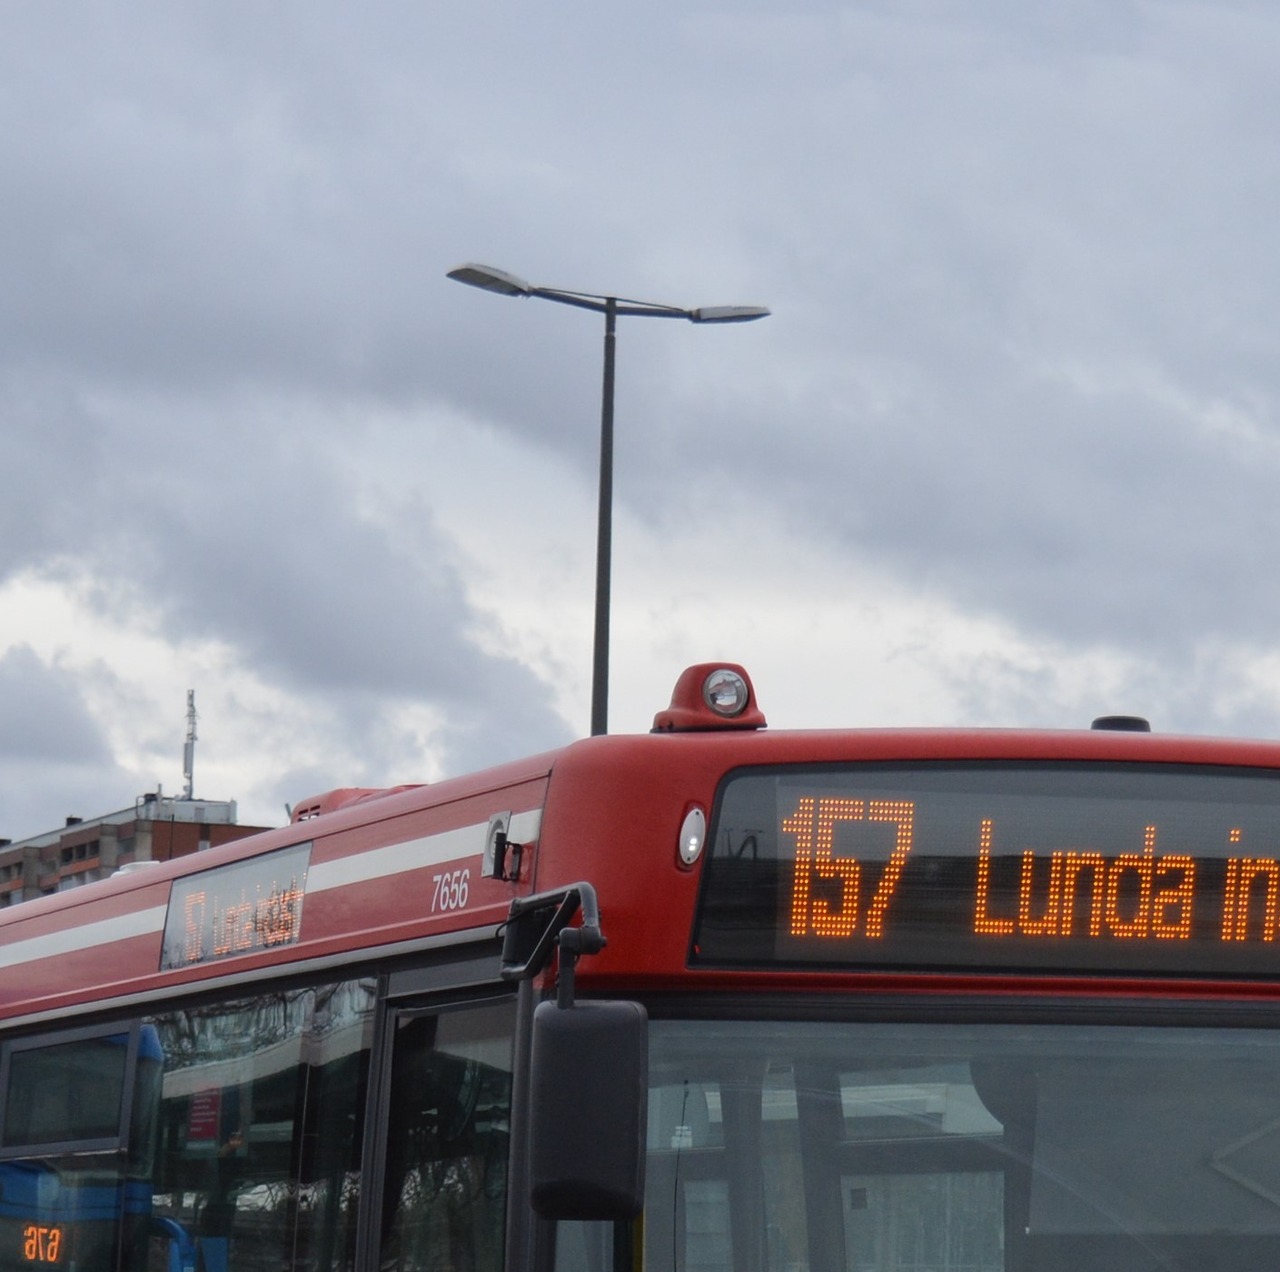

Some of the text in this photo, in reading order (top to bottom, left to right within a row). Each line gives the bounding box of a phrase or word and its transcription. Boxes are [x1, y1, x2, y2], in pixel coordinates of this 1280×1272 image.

[431, 867, 470, 913] 7656
[781, 797, 915, 938] 157
[974, 818, 1197, 939] Lunda
